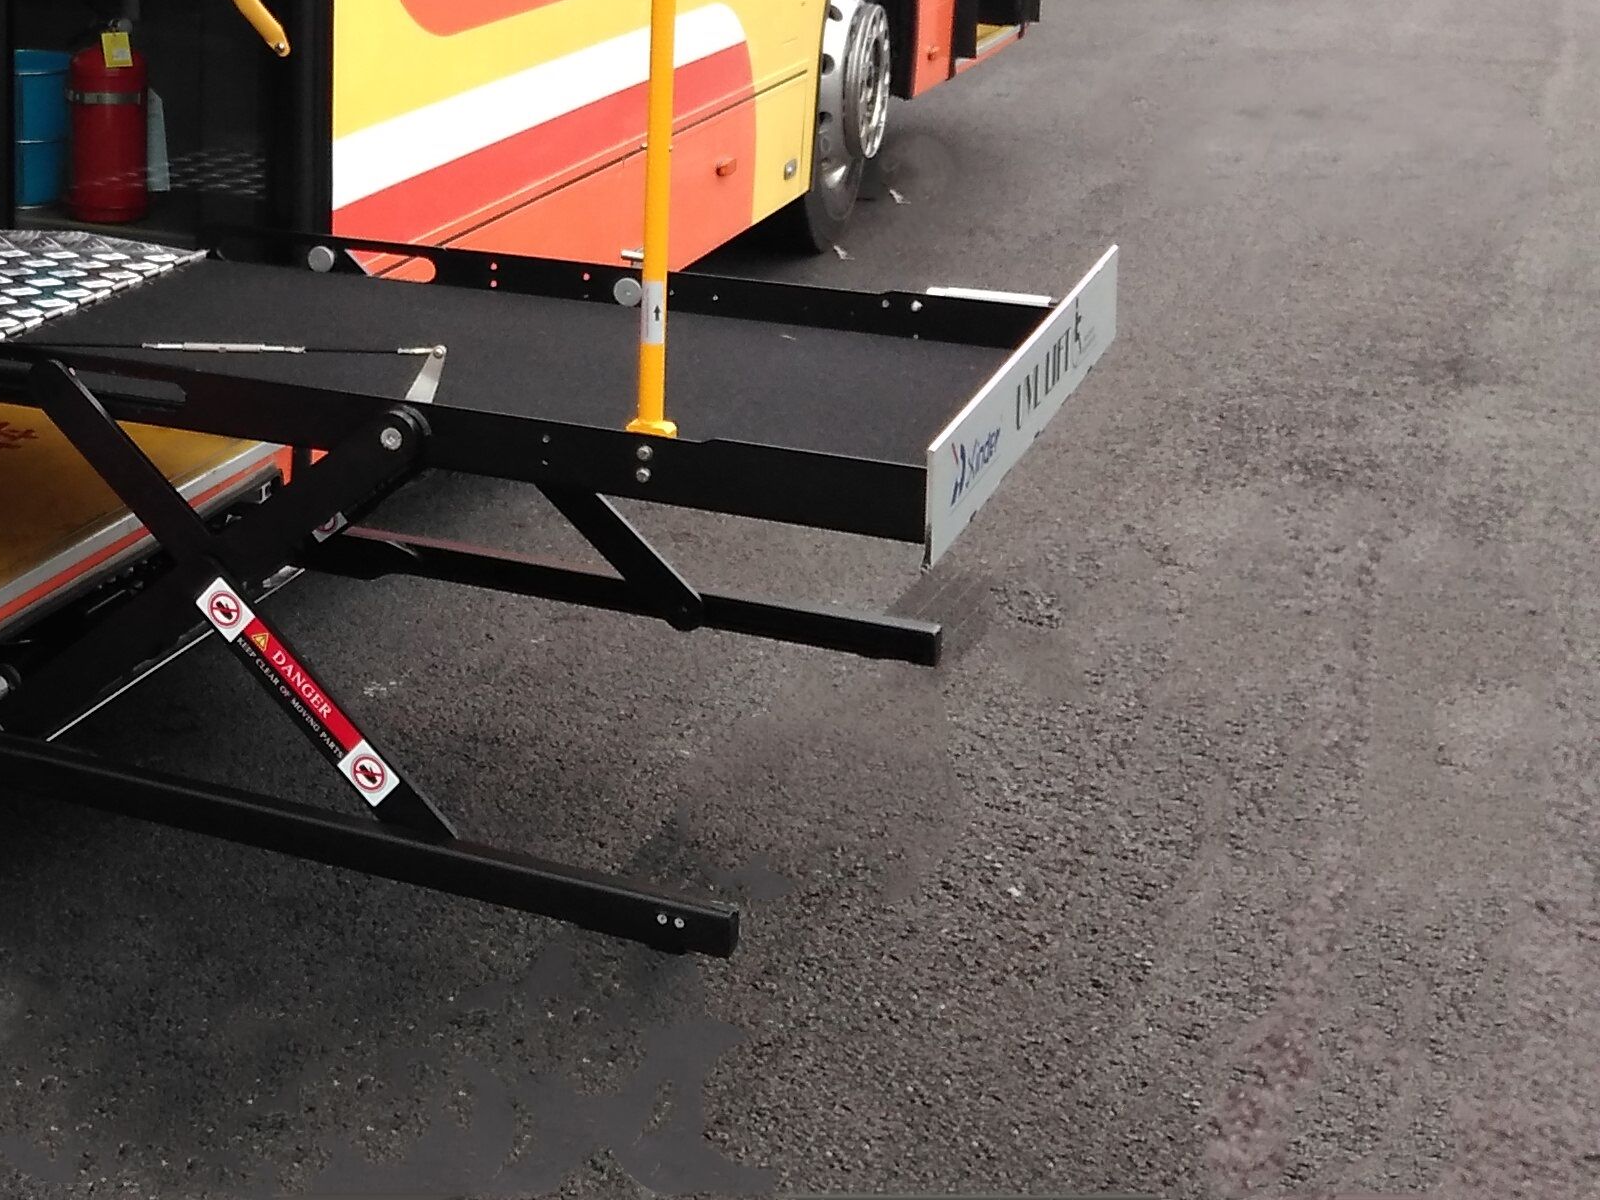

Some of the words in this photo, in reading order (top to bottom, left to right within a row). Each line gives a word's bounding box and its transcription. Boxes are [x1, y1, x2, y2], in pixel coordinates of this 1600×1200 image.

[236, 636, 257, 661] KEEP
[255, 657, 281, 686] CLEAR
[278, 685, 292, 699] OF
[289, 698, 321, 733] MOVING
[319, 730, 345, 760] PARTS
[272, 650, 333, 720] DANGER
